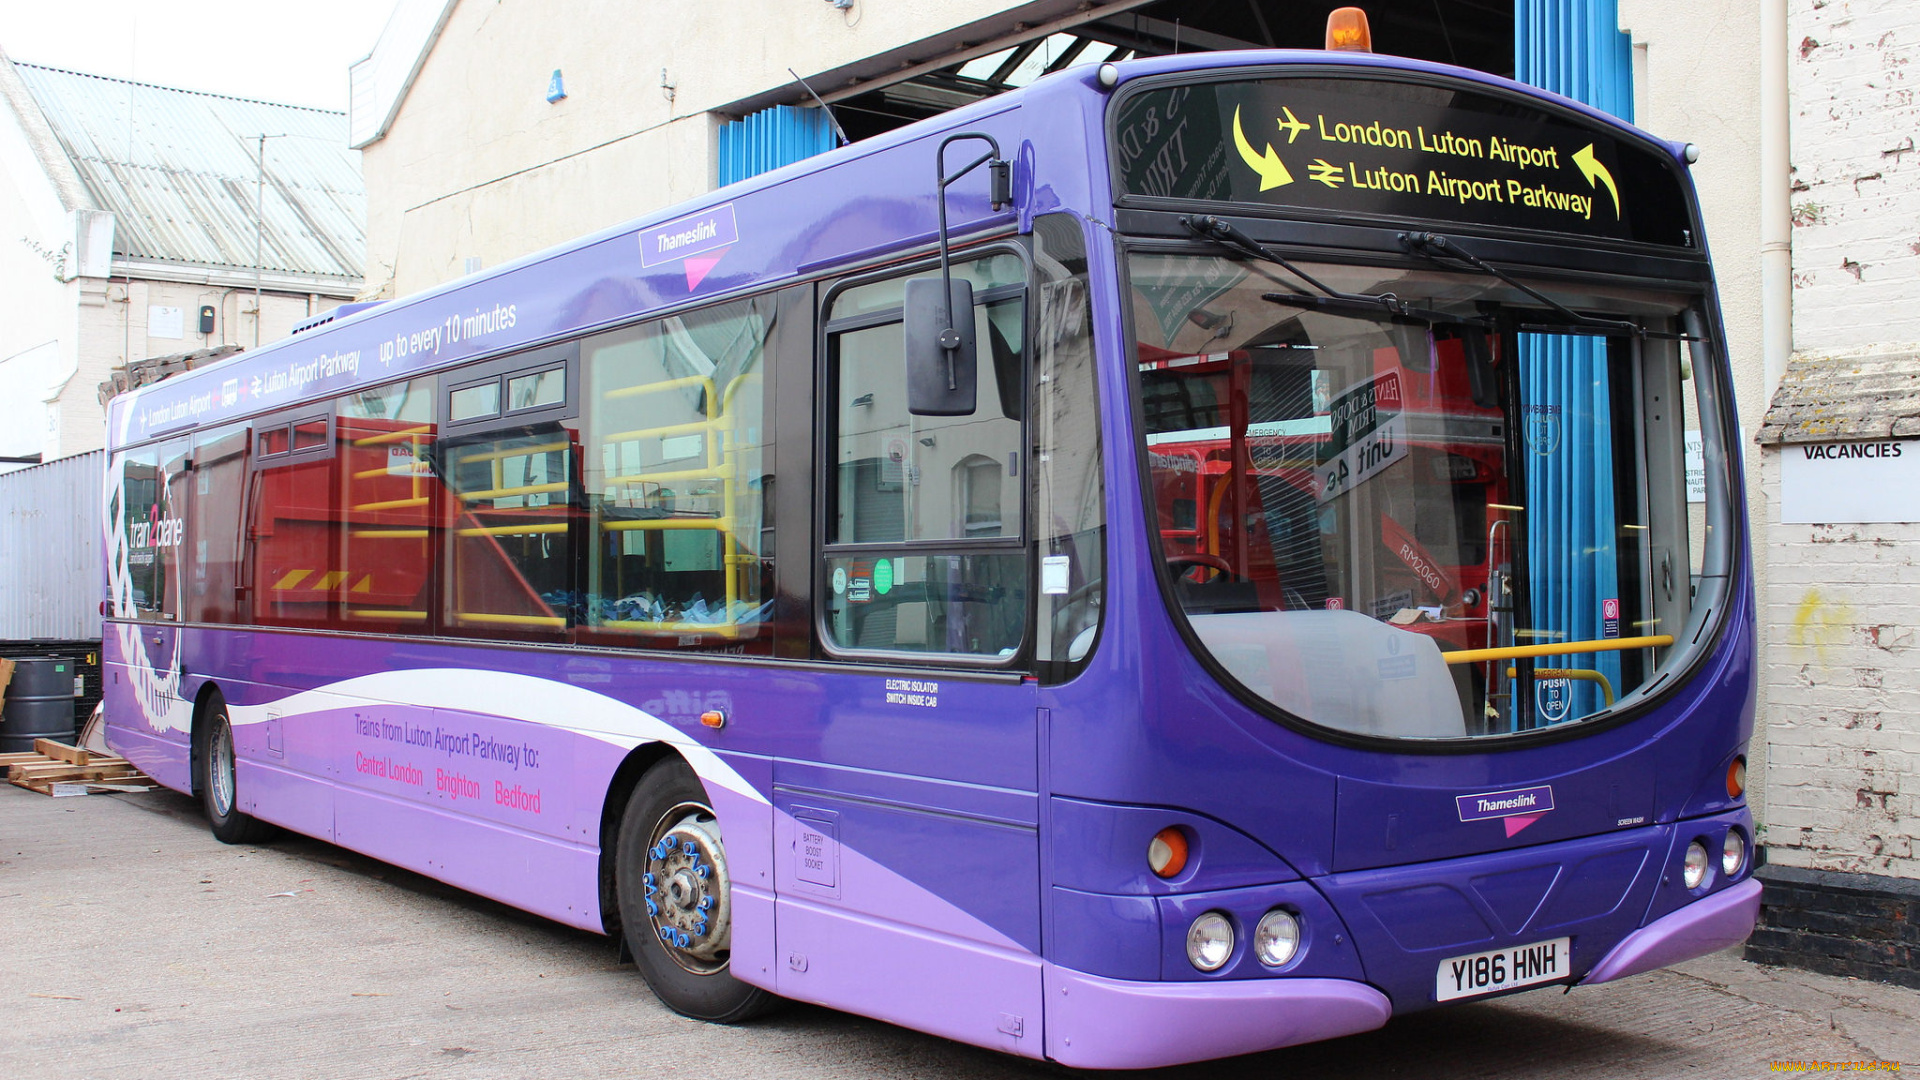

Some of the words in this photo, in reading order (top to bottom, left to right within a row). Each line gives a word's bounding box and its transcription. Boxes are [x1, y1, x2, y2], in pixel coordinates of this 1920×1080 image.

[1317, 114, 1413, 150] London
[1417, 126, 1484, 158] Luton
[1489, 136, 1560, 170] Airport
[1349, 161, 1420, 194] Luton
[1427, 170, 1504, 204] Airport
[1506, 179, 1592, 220] Parkway
[657, 218, 717, 254] Thameslink
[380, 340, 394, 367] up
[396, 333, 408, 358] to
[410, 326, 442, 355] every
[445, 314, 460, 344] 10
[463, 303, 517, 340] minutes
[264, 372, 287, 394] Luton
[288, 362, 318, 391] Airport
[320, 349, 361, 379] Parkway
[149, 408, 170, 427] London
[170, 402, 189, 420] Luton
[189, 391, 211, 418] Airport
[1685, 441, 1702, 453] NTS
[1803, 443, 1902, 460] VACANCIES
[1400, 544, 1440, 590] RM2060
[885, 678, 911, 691] ELECTRIC
[911, 681, 938, 694] ISOLATOR
[1542, 678, 1566, 689] PUSH
[886, 692, 907, 704] SWITCH
[907, 694, 925, 706] INSIDE
[925, 695, 938, 708] CAB
[1549, 689, 1559, 699] TO
[1545, 701, 1564, 711] OPEN
[354, 713, 380, 739] Trains
[382, 717, 402, 742] from
[405, 721, 432, 748] Luton
[434, 727, 470, 758] Airport
[472, 733, 520, 771] Parkway
[523, 742, 540, 768] to:
[355, 751, 386, 778] Central
[388, 757, 423, 786] London
[436, 768, 480, 800] Brighton
[494, 780, 541, 814] Bedford
[1476, 793, 1537, 813] Thameslink
[803, 832, 824, 845] BATTERY
[805, 845, 822, 857] BOOST
[804, 858, 824, 870] SOCKET
[1452, 953, 1506, 991] Y186
[1513, 943, 1556, 981] HNH
